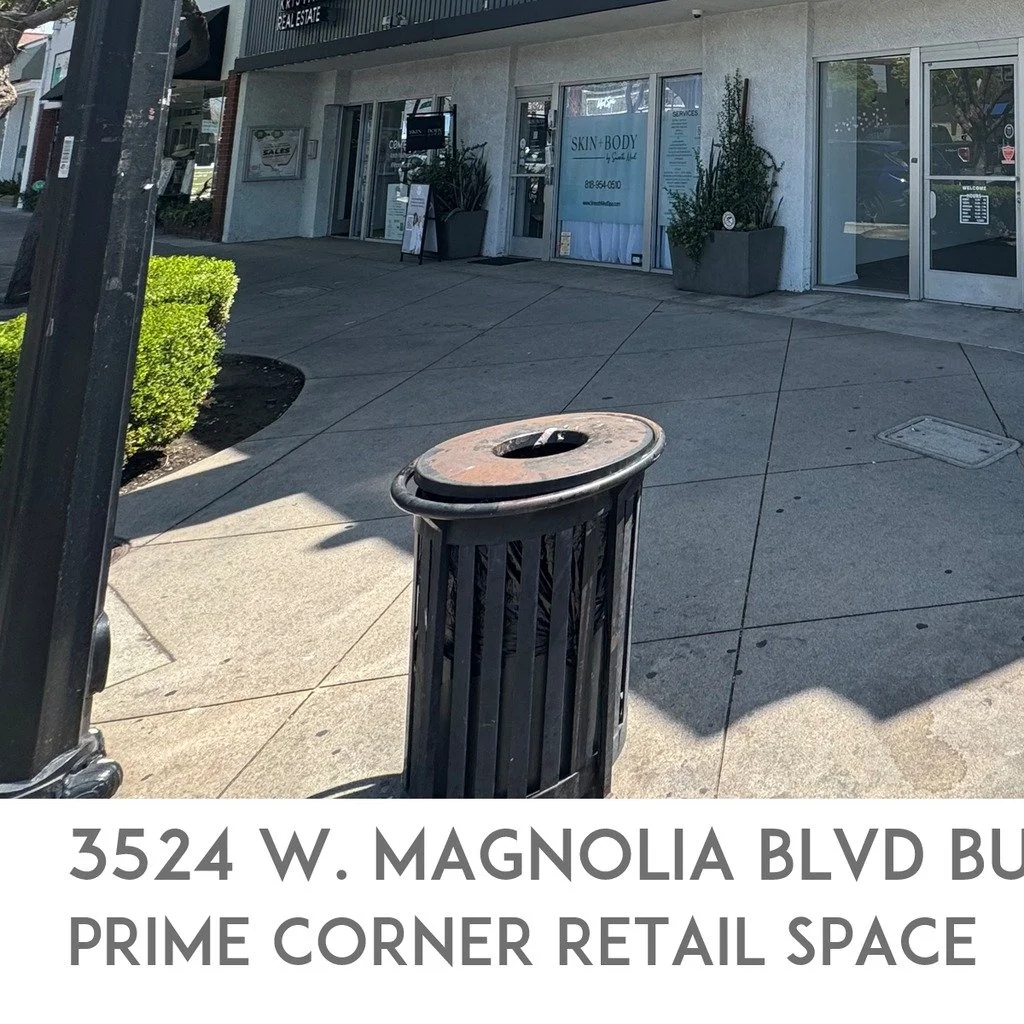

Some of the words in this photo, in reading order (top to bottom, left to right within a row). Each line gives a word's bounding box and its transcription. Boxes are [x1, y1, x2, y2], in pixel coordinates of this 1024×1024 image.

[277, 13, 295, 31] REAL
[295, 6, 321, 27] ESTATE
[672, 109, 698, 117] SERVICES
